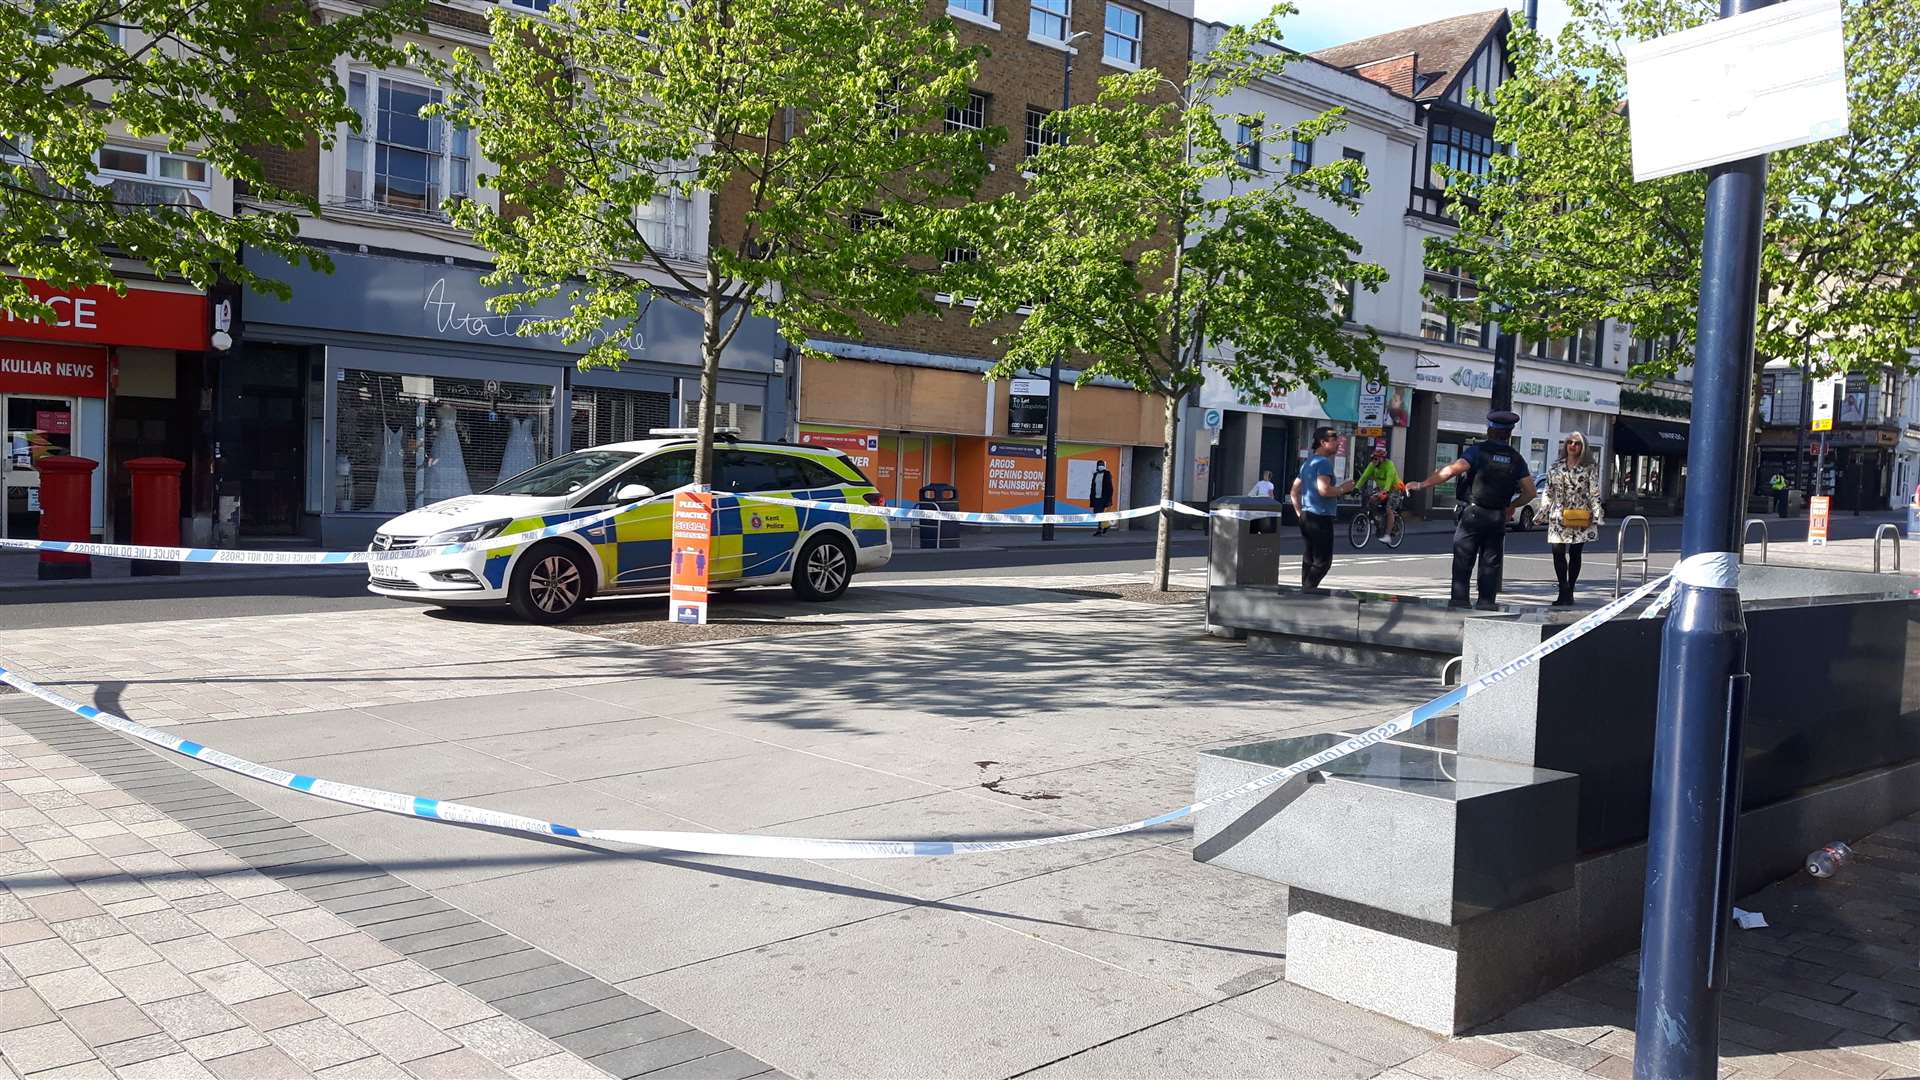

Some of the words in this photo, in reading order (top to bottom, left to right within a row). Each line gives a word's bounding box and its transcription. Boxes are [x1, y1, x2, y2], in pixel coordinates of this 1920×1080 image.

[1, 359, 52, 375] KULLAR
[56, 362, 95, 378] NEWS
[989, 459, 1016, 469] ARGOS
[989, 469, 1023, 480] OPENING
[1023, 470, 1044, 481] SOON
[988, 479, 998, 489] IN
